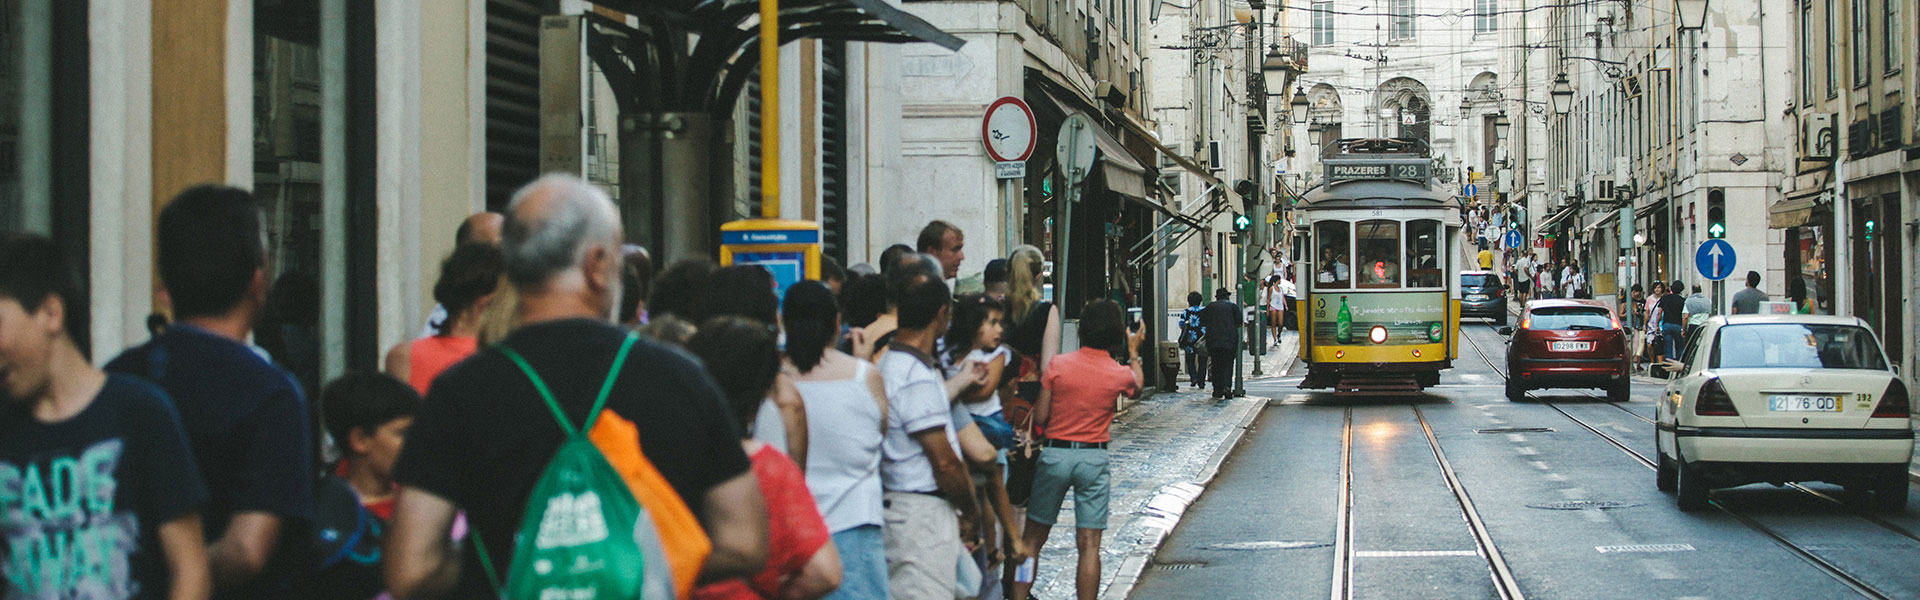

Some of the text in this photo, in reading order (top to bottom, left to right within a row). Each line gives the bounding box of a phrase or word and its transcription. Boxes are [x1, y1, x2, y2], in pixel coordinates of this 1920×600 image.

[1334, 165, 1417, 177] PRAZERES 28
[1556, 342, 1574, 350] 0298
[1857, 393, 1872, 402] 392
[1776, 397, 1835, 411] 21-76-QD
[0, 441, 117, 524] FADE
